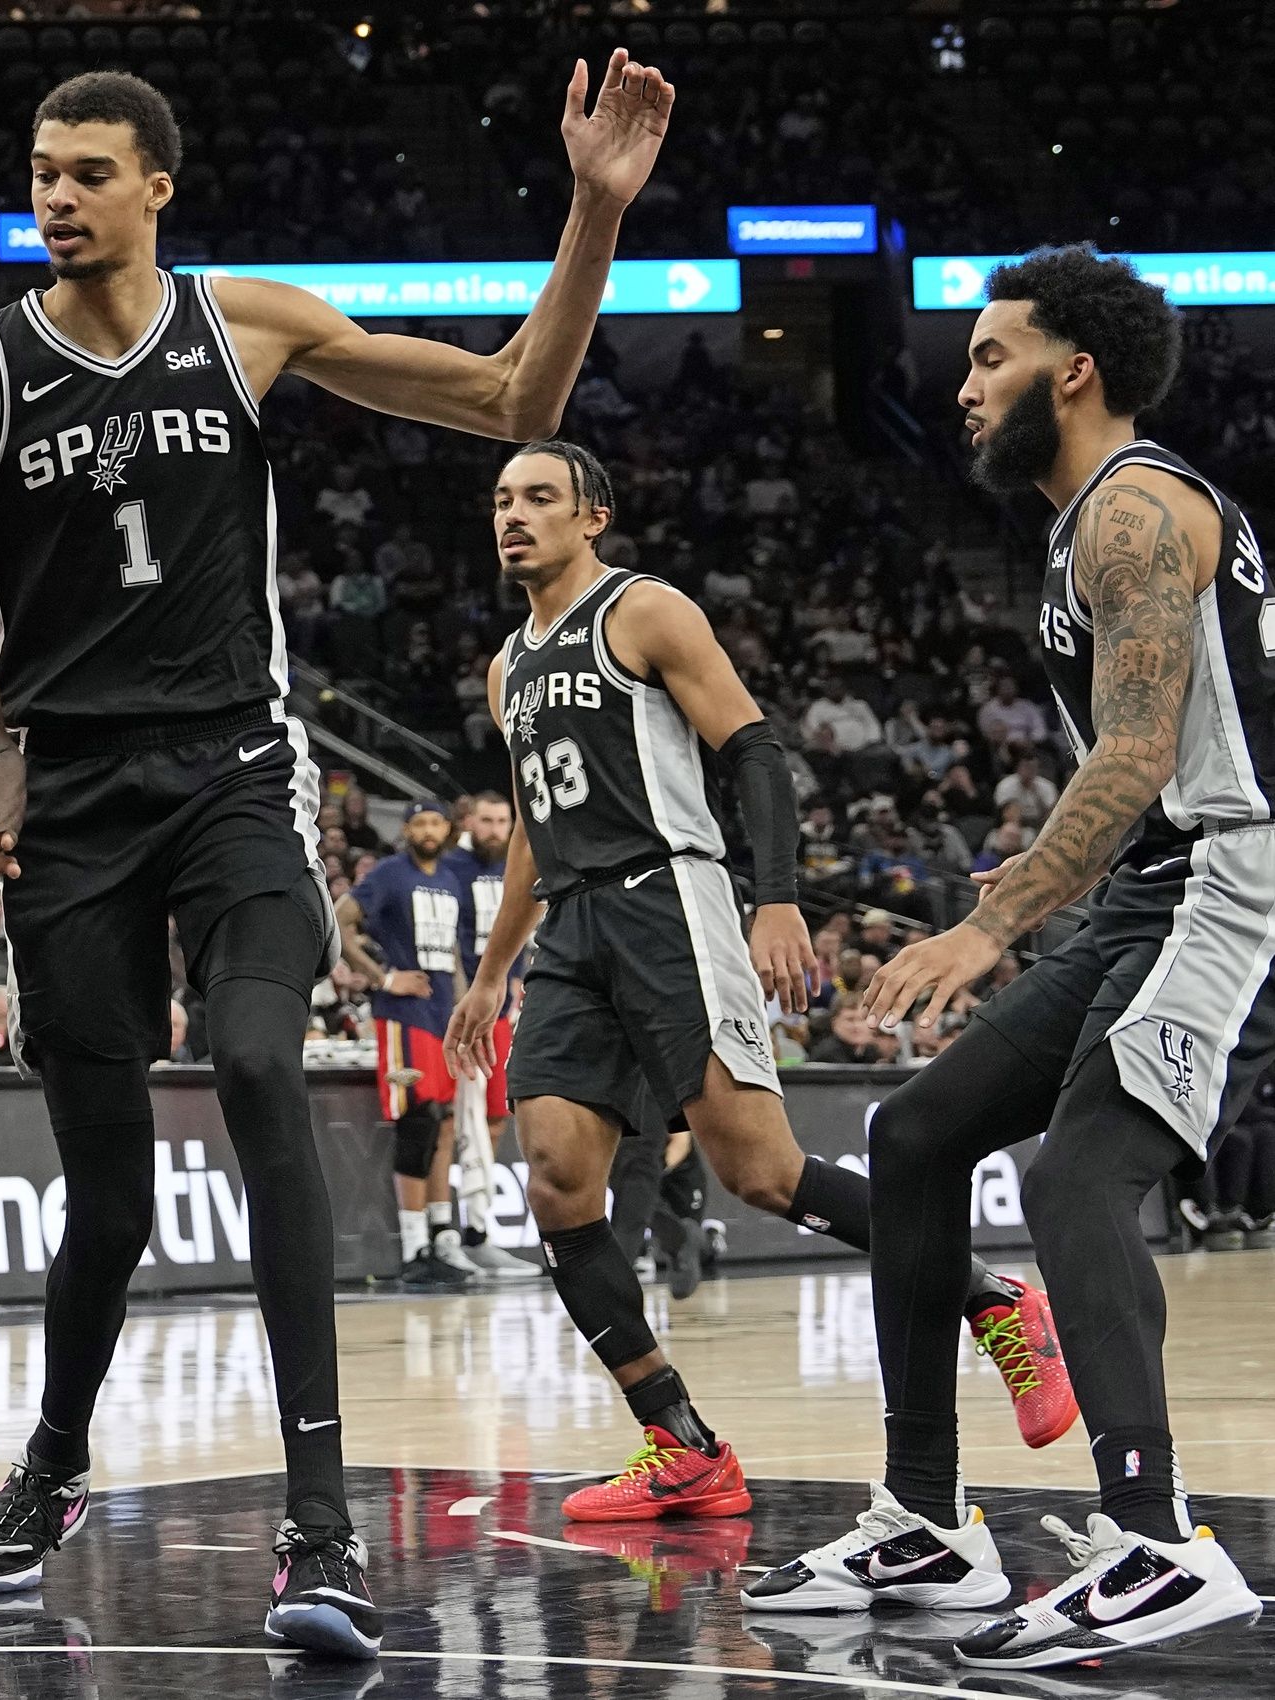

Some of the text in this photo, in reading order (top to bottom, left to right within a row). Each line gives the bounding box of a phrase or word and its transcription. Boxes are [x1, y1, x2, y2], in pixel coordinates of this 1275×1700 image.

[165, 345, 212, 370] Self.
[113, 499, 162, 587] 1
[557, 627, 589, 646] Self.
[520, 736, 590, 824] 33
